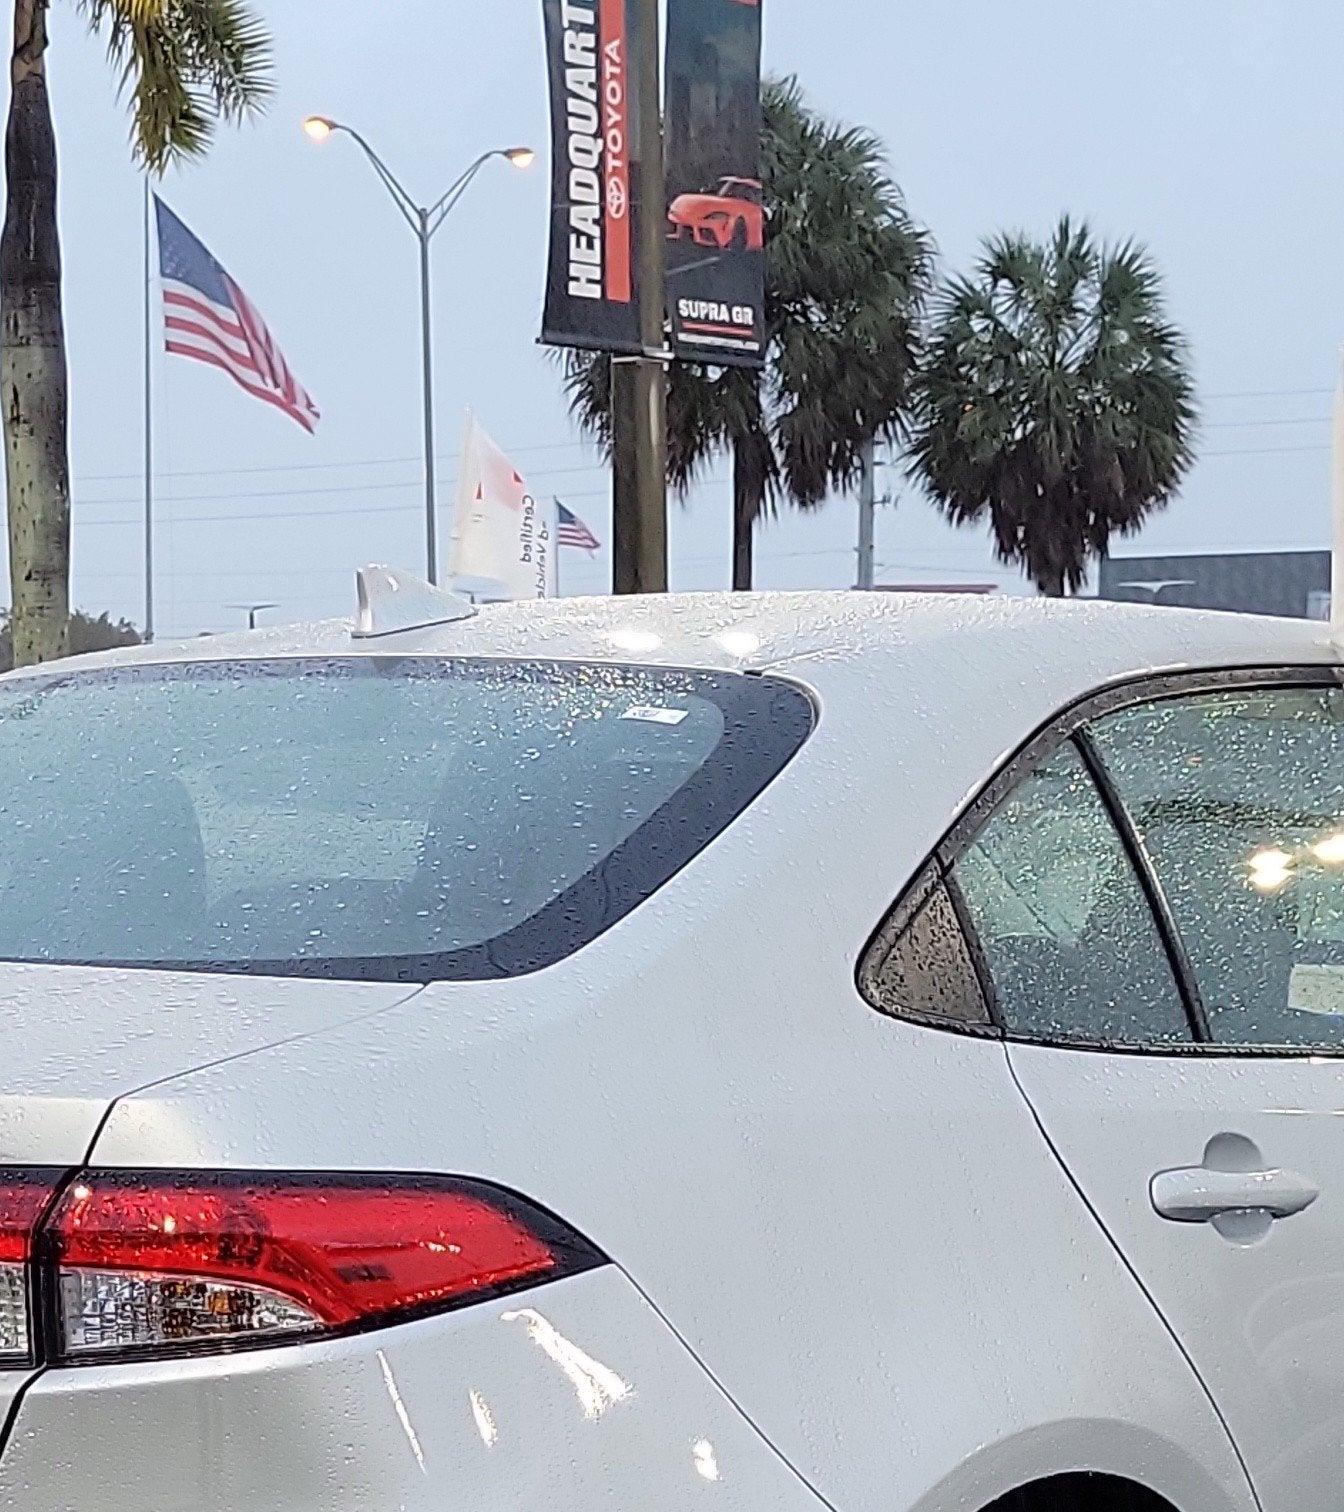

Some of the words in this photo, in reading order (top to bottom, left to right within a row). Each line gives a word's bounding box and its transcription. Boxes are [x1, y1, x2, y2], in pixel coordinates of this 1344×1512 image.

[606, 38, 625, 173] TOYOTA
[678, 299, 729, 323] SUPRA
[732, 306, 753, 325] GR
